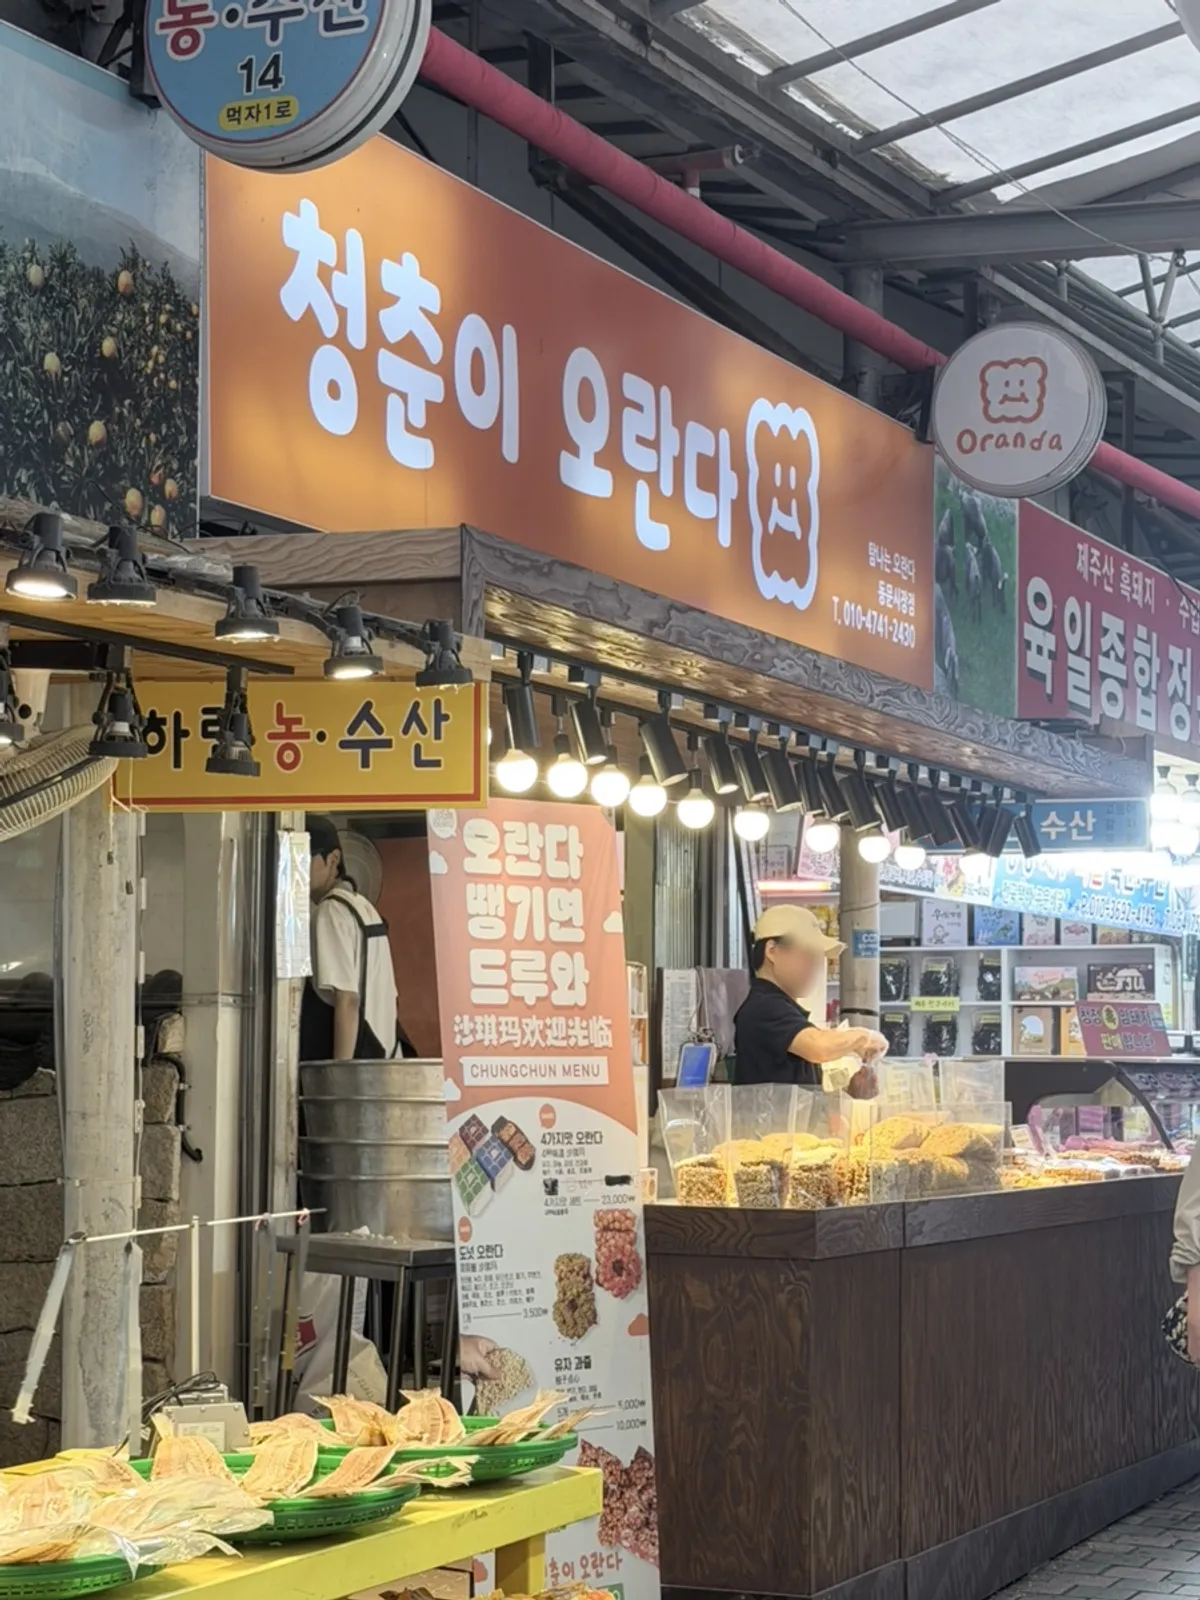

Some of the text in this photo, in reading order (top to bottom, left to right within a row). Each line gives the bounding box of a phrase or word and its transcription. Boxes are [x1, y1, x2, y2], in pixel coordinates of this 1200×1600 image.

[237, 52, 284, 95] 14
[226, 100, 292, 126] 먹자1로
[280, 198, 738, 551] 청춘이 오란다
[956, 428, 1063, 455] Oranda
[892, 553, 915, 584] 오란다
[1076, 541, 1114, 594] 제주산
[1119, 561, 1155, 614] 흑돼지
[1023, 576, 1200, 742] 육일종합정
[266, 699, 451, 772] 농·수산
[462, 817, 584, 880] 오란다
[468, 948, 590, 1008] 드루와
[453, 1014, 613, 1049] 沙琪玛欢迎光临
[470, 1062, 600, 1078] CHUNGCHUN MENU
[540, 1130, 604, 1145] 4가지맛 오란다
[477, 1244, 504, 1259] 오란다
[554, 1357, 572, 1371] 유자
[545, 1551, 623, 1587] 춘이 오란다
